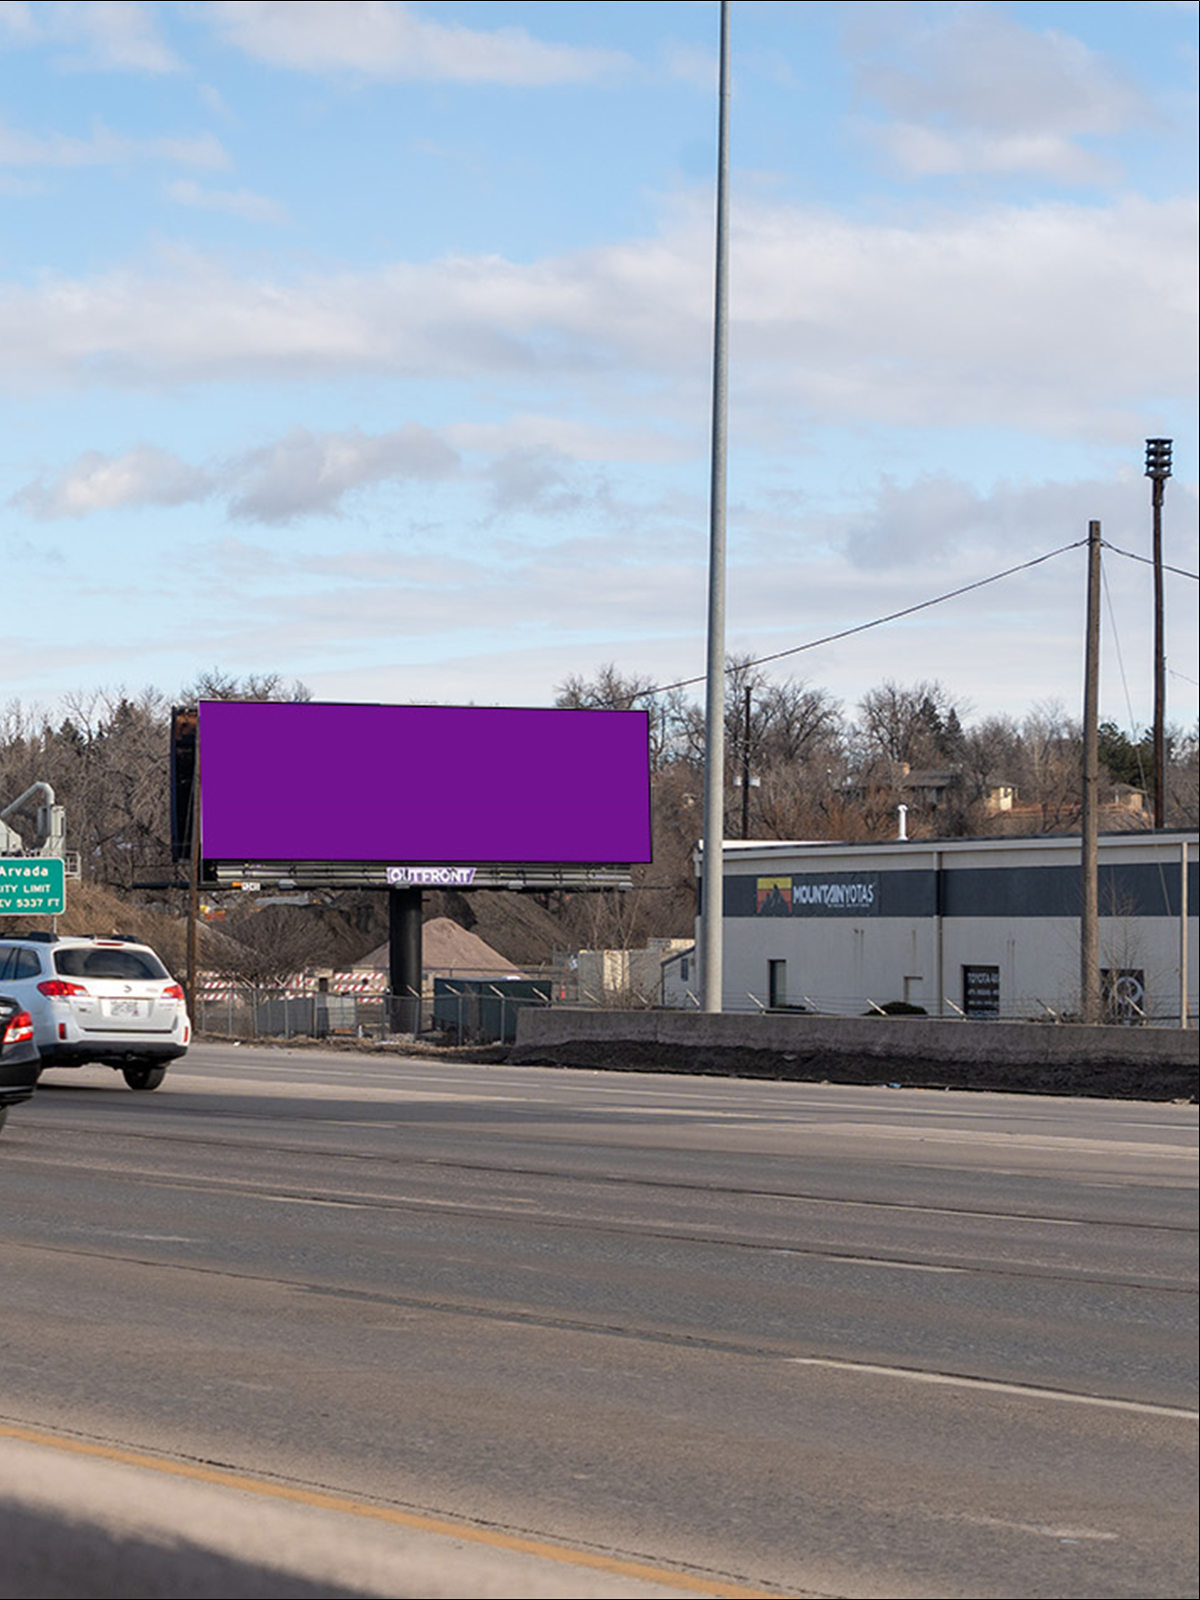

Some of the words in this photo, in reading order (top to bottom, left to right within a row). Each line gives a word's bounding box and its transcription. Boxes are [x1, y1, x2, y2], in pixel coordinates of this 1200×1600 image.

[390, 869, 471, 882] OUTFRONT
[23, 884, 51, 893] LIMIT
[16, 899, 43, 908] 5337
[47, 898, 60, 907] FT
